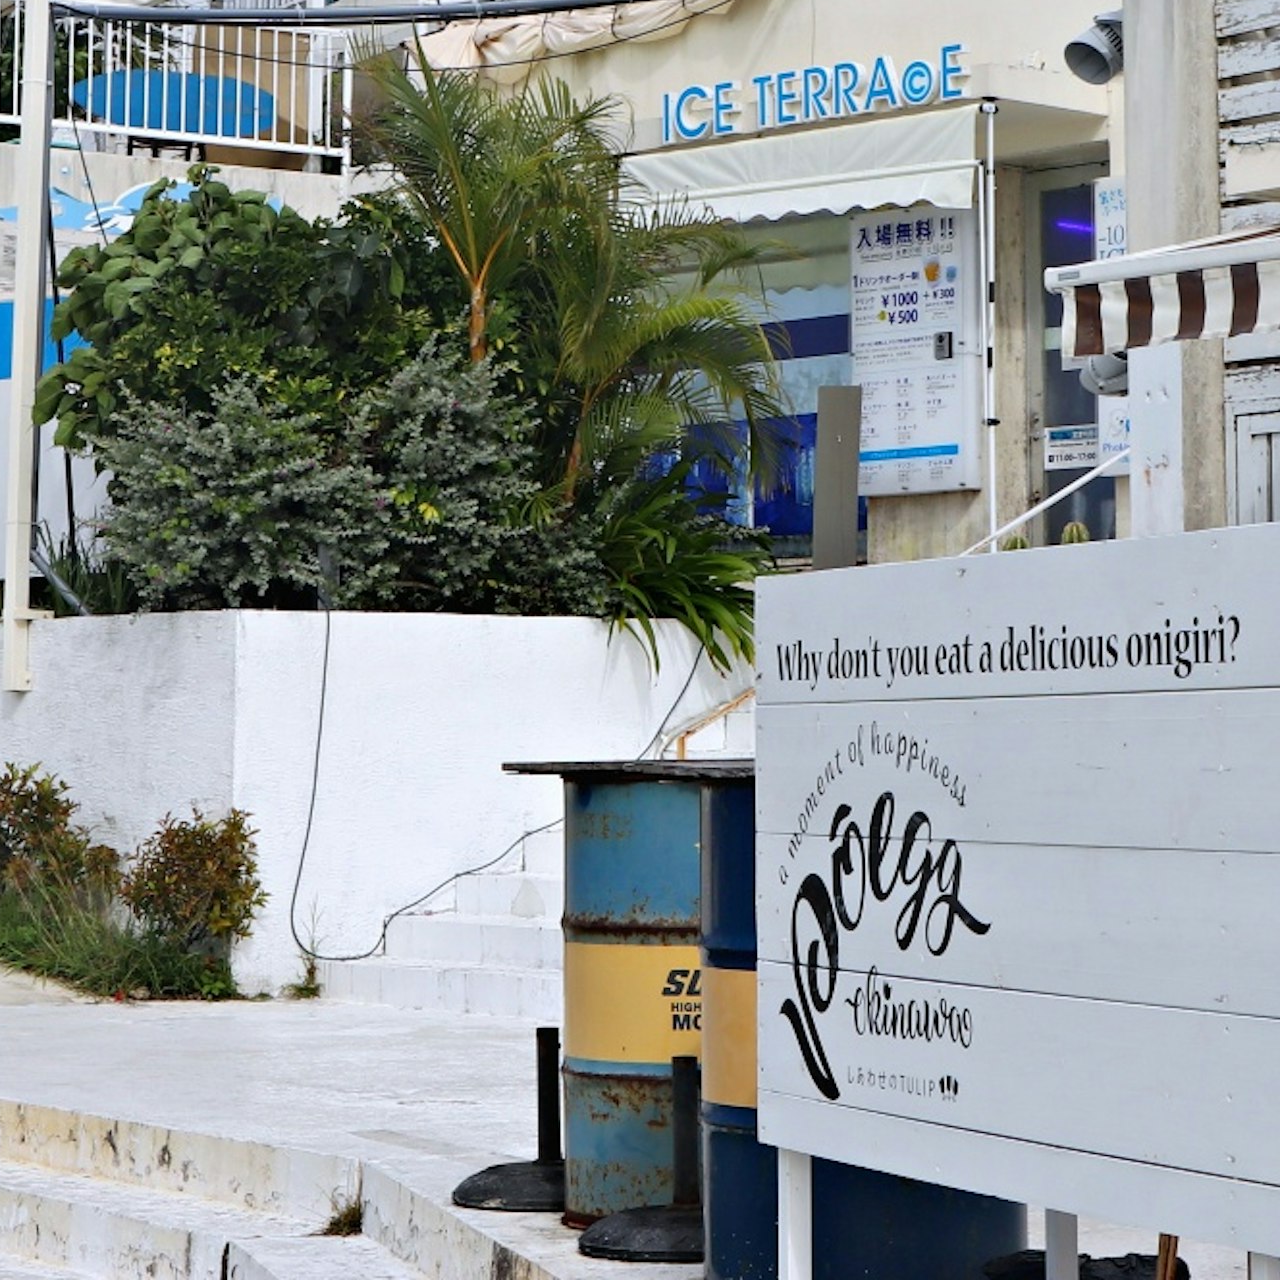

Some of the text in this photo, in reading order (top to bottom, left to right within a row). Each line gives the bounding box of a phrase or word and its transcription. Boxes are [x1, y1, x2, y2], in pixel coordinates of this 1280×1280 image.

[662, 83, 734, 145] ICE
[881, 291, 919, 308] ¥1000
[888, 309, 919, 326] ¥500
[776, 615, 1241, 690] Why don't you eat a delicious onigiri?
[779, 720, 968, 886] a moment of happiness
